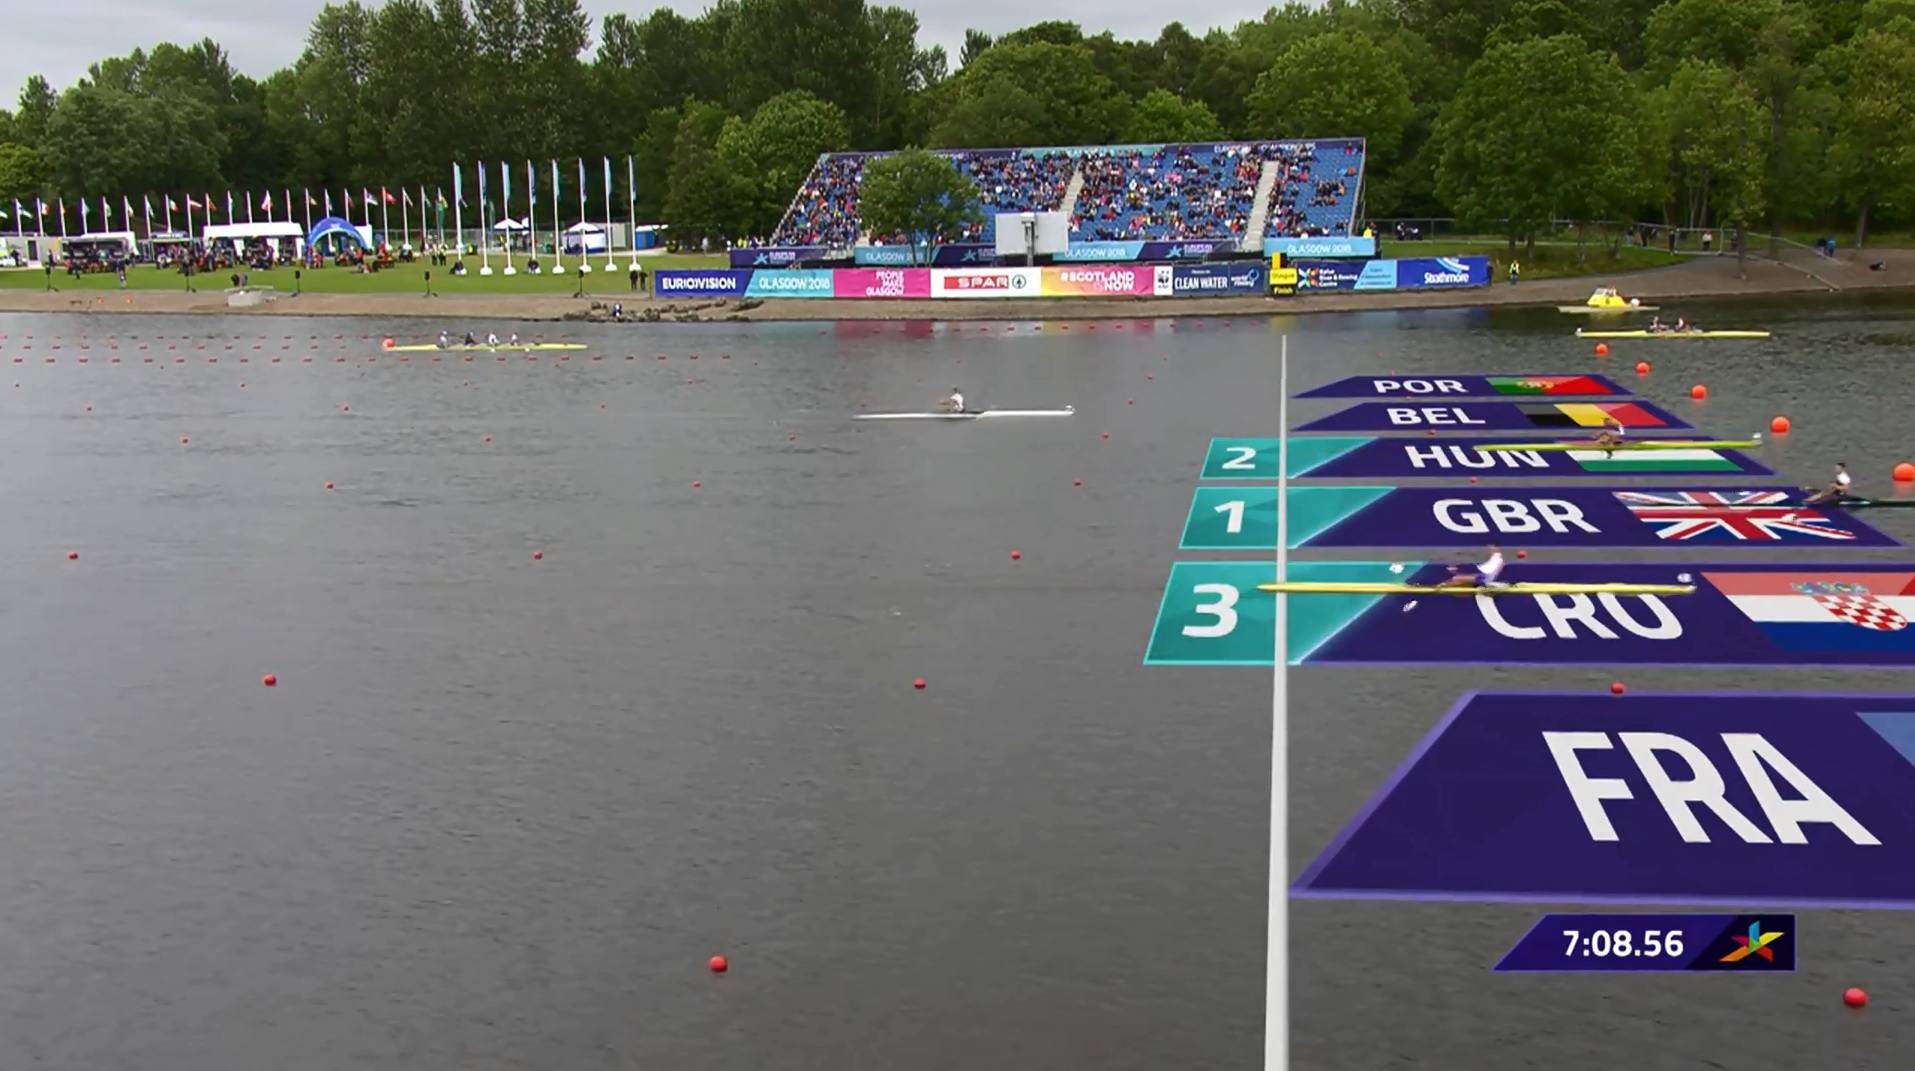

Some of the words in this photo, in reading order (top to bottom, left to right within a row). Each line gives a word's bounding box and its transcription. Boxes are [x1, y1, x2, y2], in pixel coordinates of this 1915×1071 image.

[1287, 243, 1331, 254] GLASGOW
[1332, 243, 1352, 253] 2018
[865, 252, 905, 262] GLASGOW
[876, 271, 904, 280] PEOPLE
[1060, 271, 1135, 283] #SCOTLAND
[759, 278, 806, 289] GLASGOW
[808, 278, 831, 289] 2018
[957, 277, 1008, 288] SPAR
[1104, 280, 1134, 291] NOW
[1175, 276, 1199, 289] CLEAN
[1200, 276, 1228, 288] WATER
[866, 287, 904, 296] GLASGOW
[1273, 286, 1294, 295] Finish
